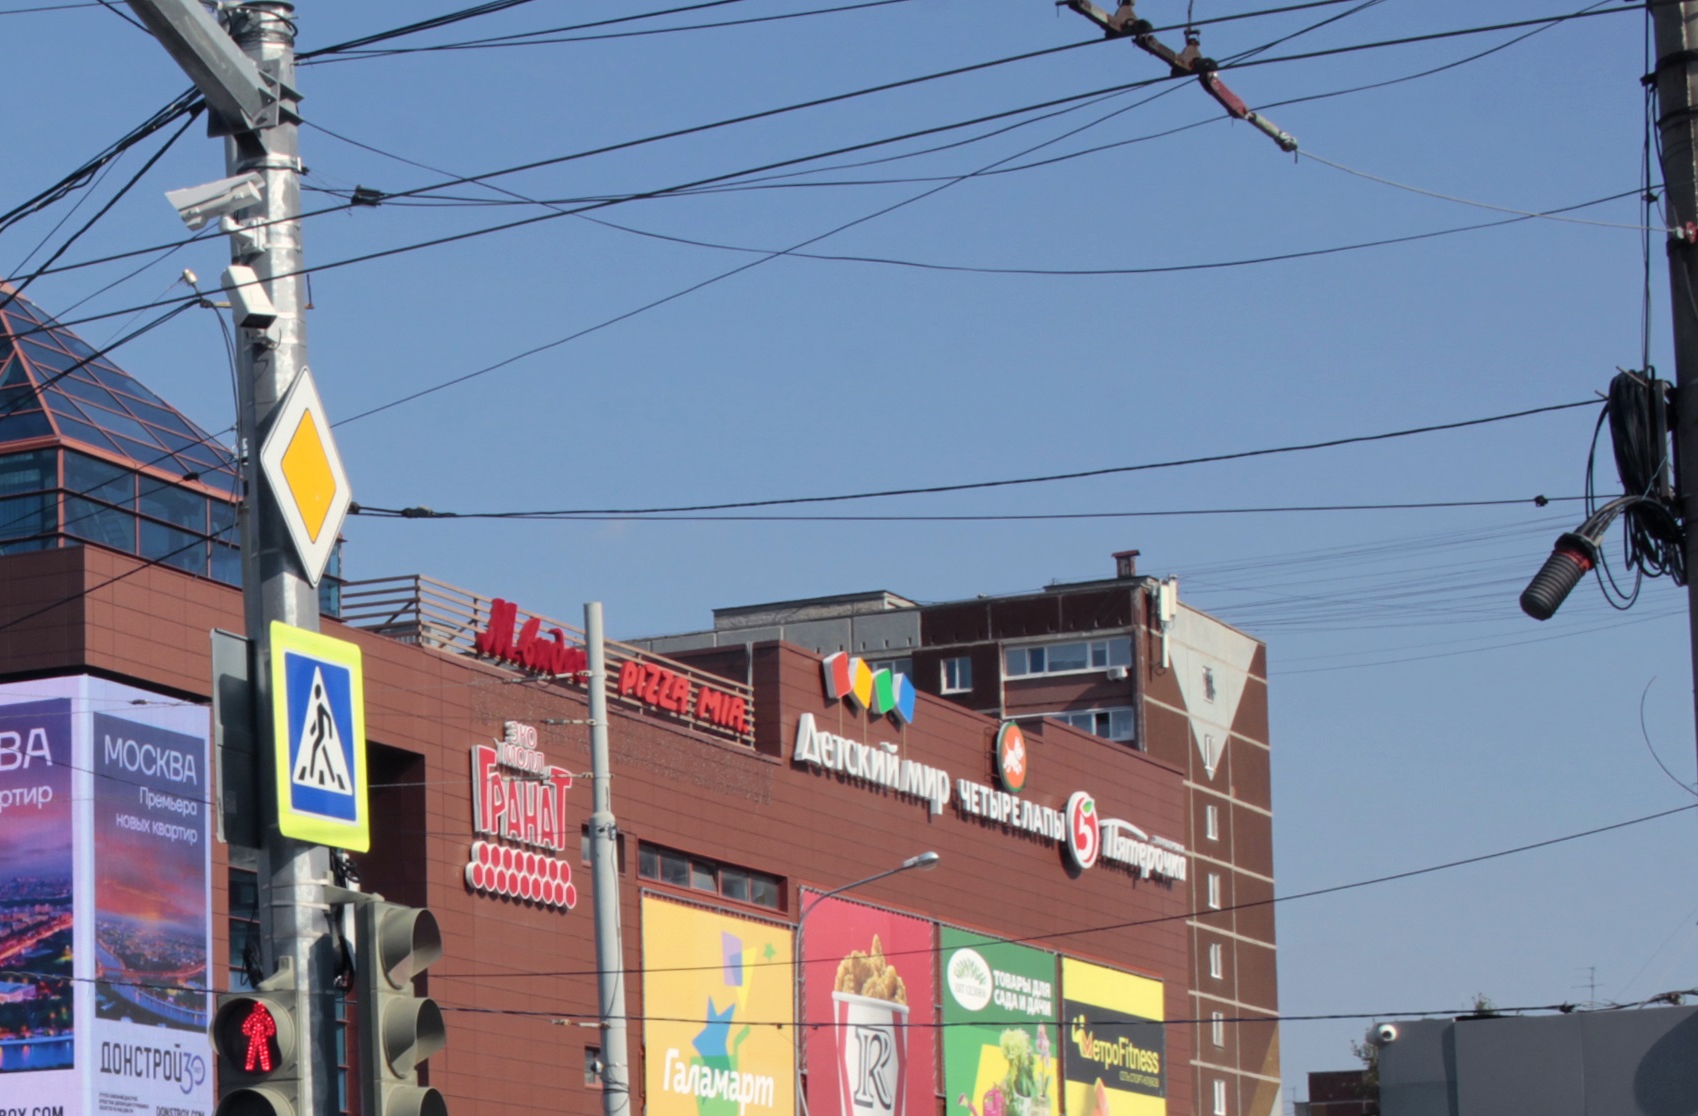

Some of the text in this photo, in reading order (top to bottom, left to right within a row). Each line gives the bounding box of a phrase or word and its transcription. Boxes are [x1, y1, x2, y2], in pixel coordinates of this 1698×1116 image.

[618, 661, 690, 714] PIZZA
[104, 734, 197, 786] МОСКВА
[497, 741, 544, 773] МОЛЛ
[504, 721, 537, 749] ЭКО
[794, 713, 950, 814] Детский мир
[139, 786, 197, 817] Премьера
[471, 745, 572, 851] ГРАНАТ
[957, 778, 1066, 841] ЧЕТЫРЕ ЛАПЫ
[116, 813, 198, 846] новых квартир
[993, 970, 1051, 998] ТОВАРЫ ДЛЯ
[993, 989, 1051, 1017] САДА И ДАЧИ
[100, 1041, 206, 1094] ДОНСТРОЙ 30
[663, 1048, 774, 1116] Галамарт
